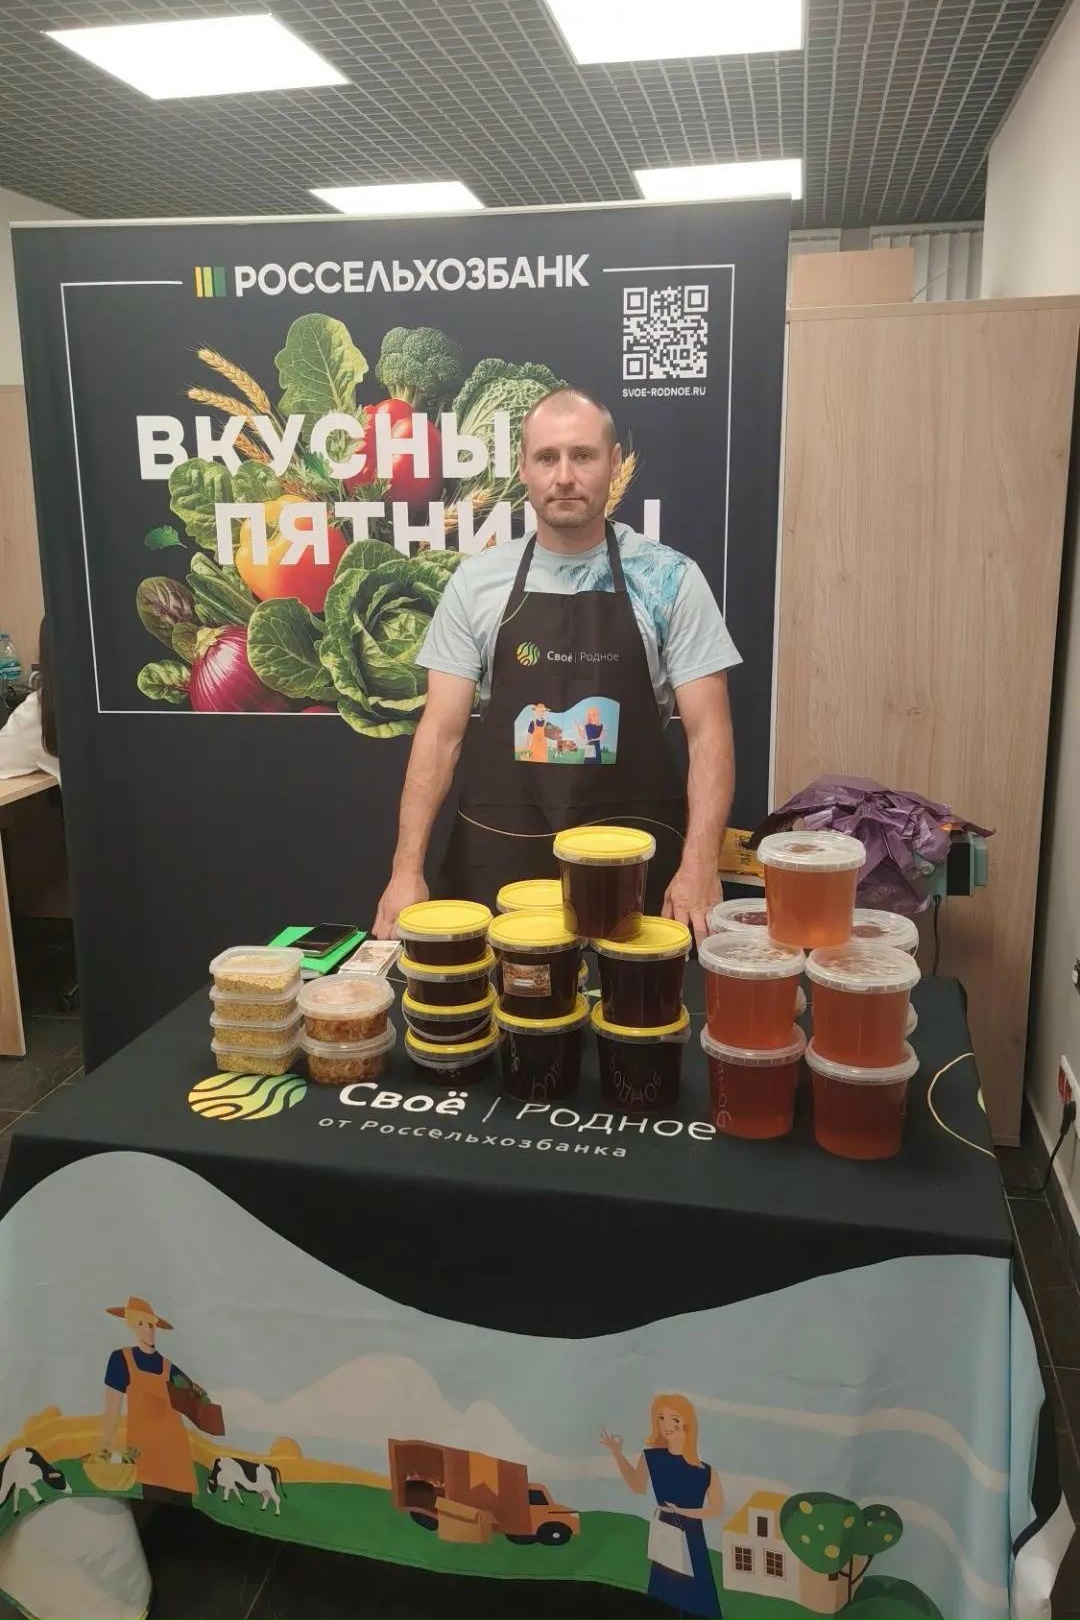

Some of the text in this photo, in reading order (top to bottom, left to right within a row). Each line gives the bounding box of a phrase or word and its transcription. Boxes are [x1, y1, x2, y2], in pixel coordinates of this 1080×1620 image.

[234, 253, 591, 298] РОССЕЛЬХОЗБАНК
[622, 386, 707, 398] SVOE-RODNOE.RU
[135, 411, 512, 481] ВКУСНЫ
[214, 499, 661, 566] ПЯТНИ
[546, 651, 620, 663] Своё Родное
[339, 1082, 717, 1141] Своё Родное
[318, 1118, 627, 1158] от Россельхозбанка
